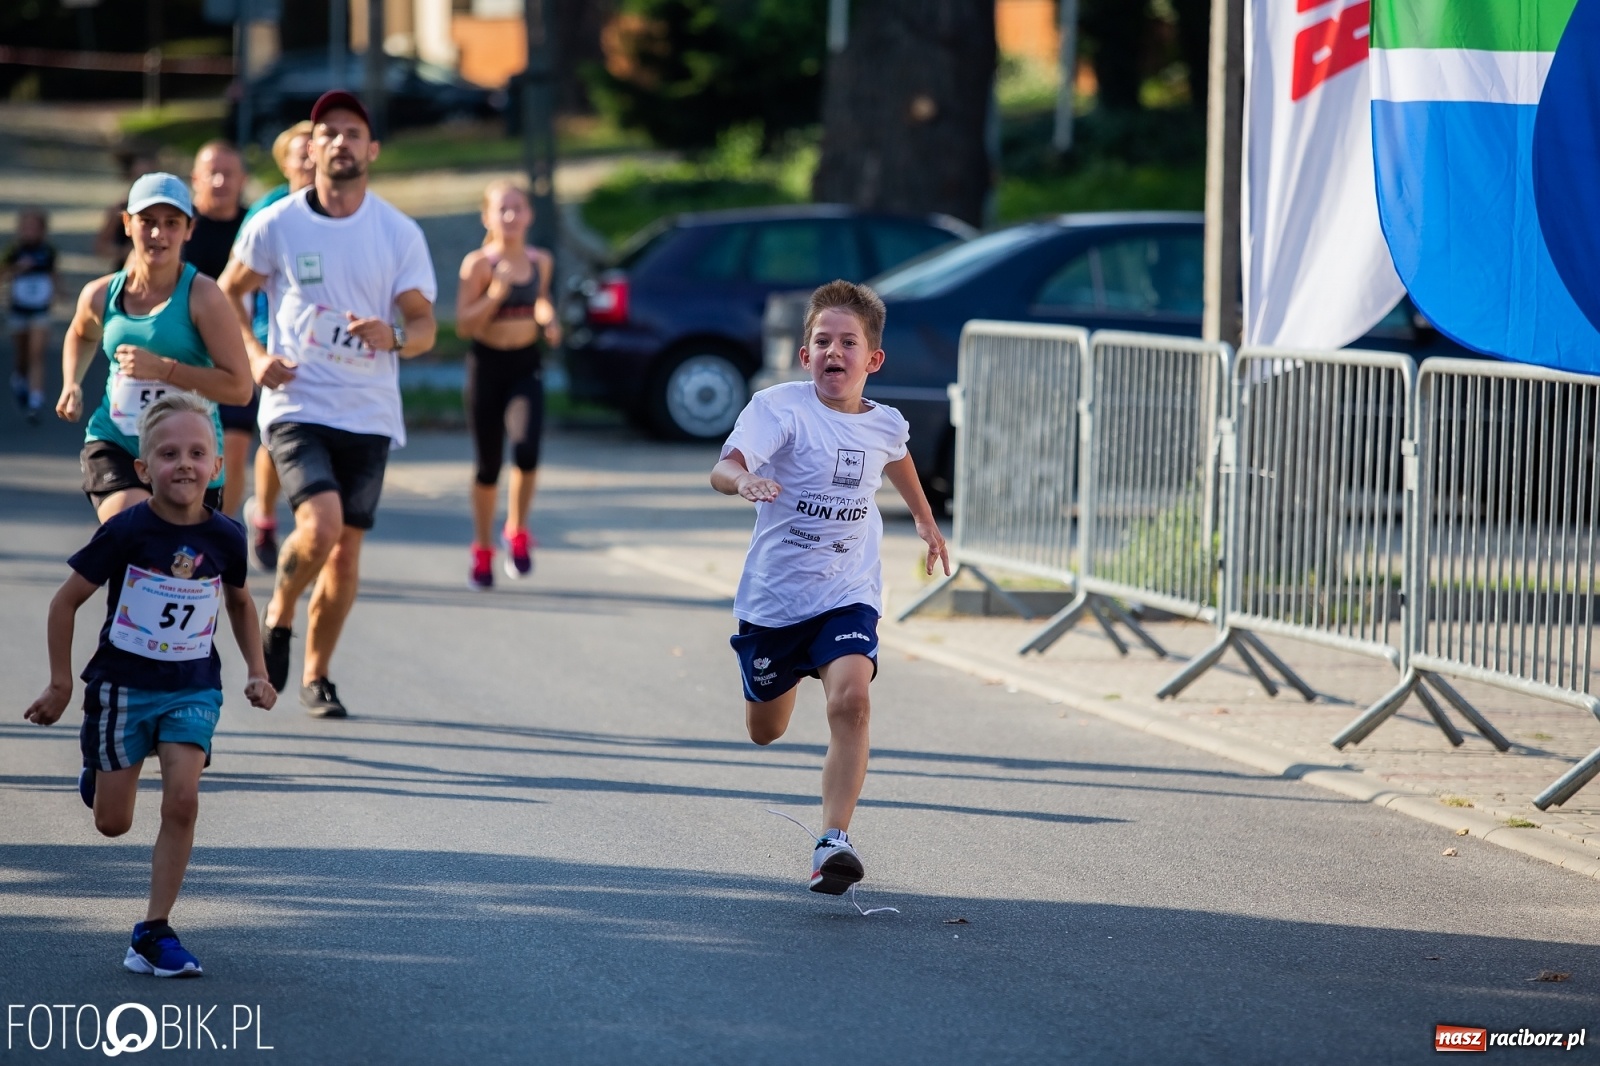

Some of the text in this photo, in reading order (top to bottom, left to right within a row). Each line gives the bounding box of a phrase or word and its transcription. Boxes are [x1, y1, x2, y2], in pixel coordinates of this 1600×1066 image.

[796, 500, 868, 521] RUN KIDS
[159, 602, 195, 630] 57
